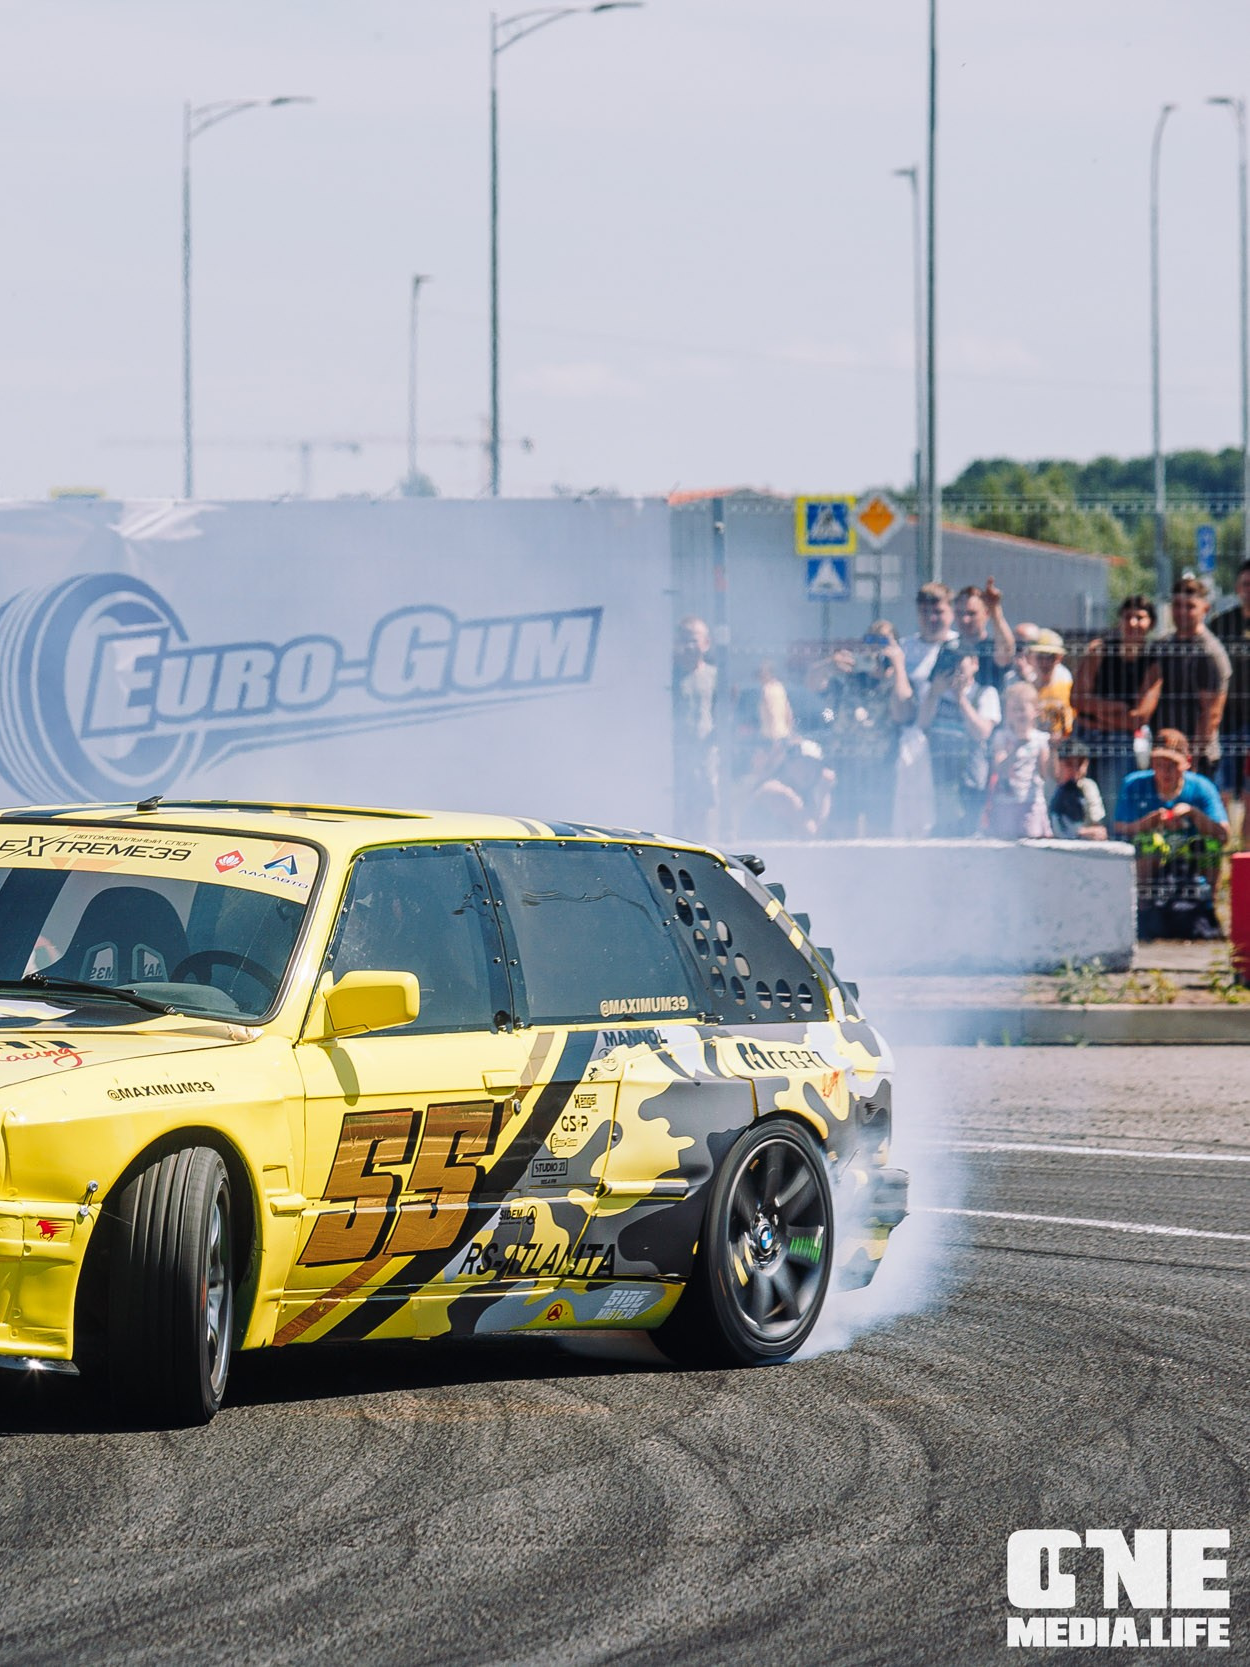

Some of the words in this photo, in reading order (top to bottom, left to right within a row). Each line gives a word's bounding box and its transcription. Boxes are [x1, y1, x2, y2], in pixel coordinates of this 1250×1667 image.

[73, 834, 162, 845] АВТОМОБИЛЬНЫЙ
[164, 839, 199, 848] СПОРТ
[599, 995, 689, 1017] @MAXIMUM39
[602, 1029, 668, 1047] MANNOL
[107, 1080, 216, 1102] @MAXIMUM39
[534, 1162, 557, 1173] STUDIO
[297, 1099, 506, 1268] 55
[499, 1208, 524, 1220] SIDEM
[458, 1242, 616, 1277] RS-ATLANTA
